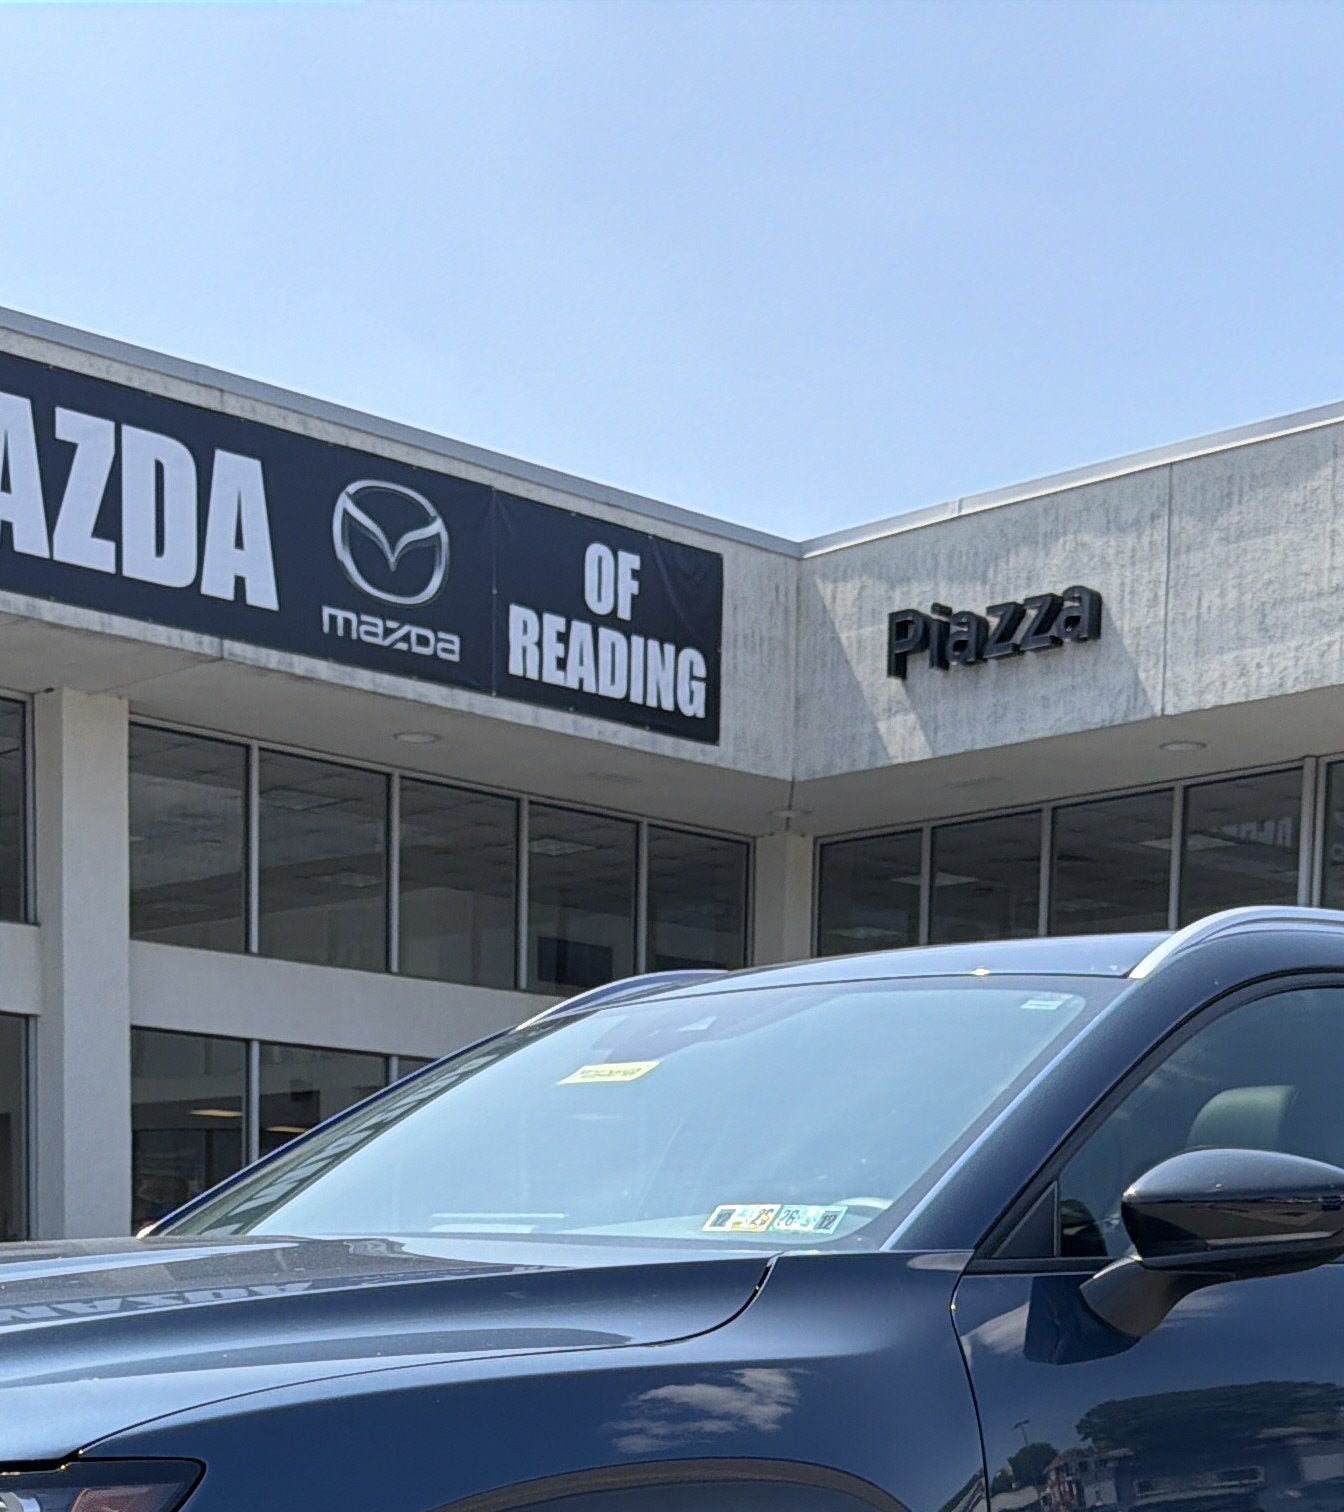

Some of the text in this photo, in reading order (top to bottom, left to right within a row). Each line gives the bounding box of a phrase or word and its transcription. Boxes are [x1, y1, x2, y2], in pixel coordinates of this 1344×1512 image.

[583, 542, 641, 621] OF
[321, 605, 461, 662] mazda
[507, 603, 708, 719] READING
[887, 584, 1103, 680] Piazza
